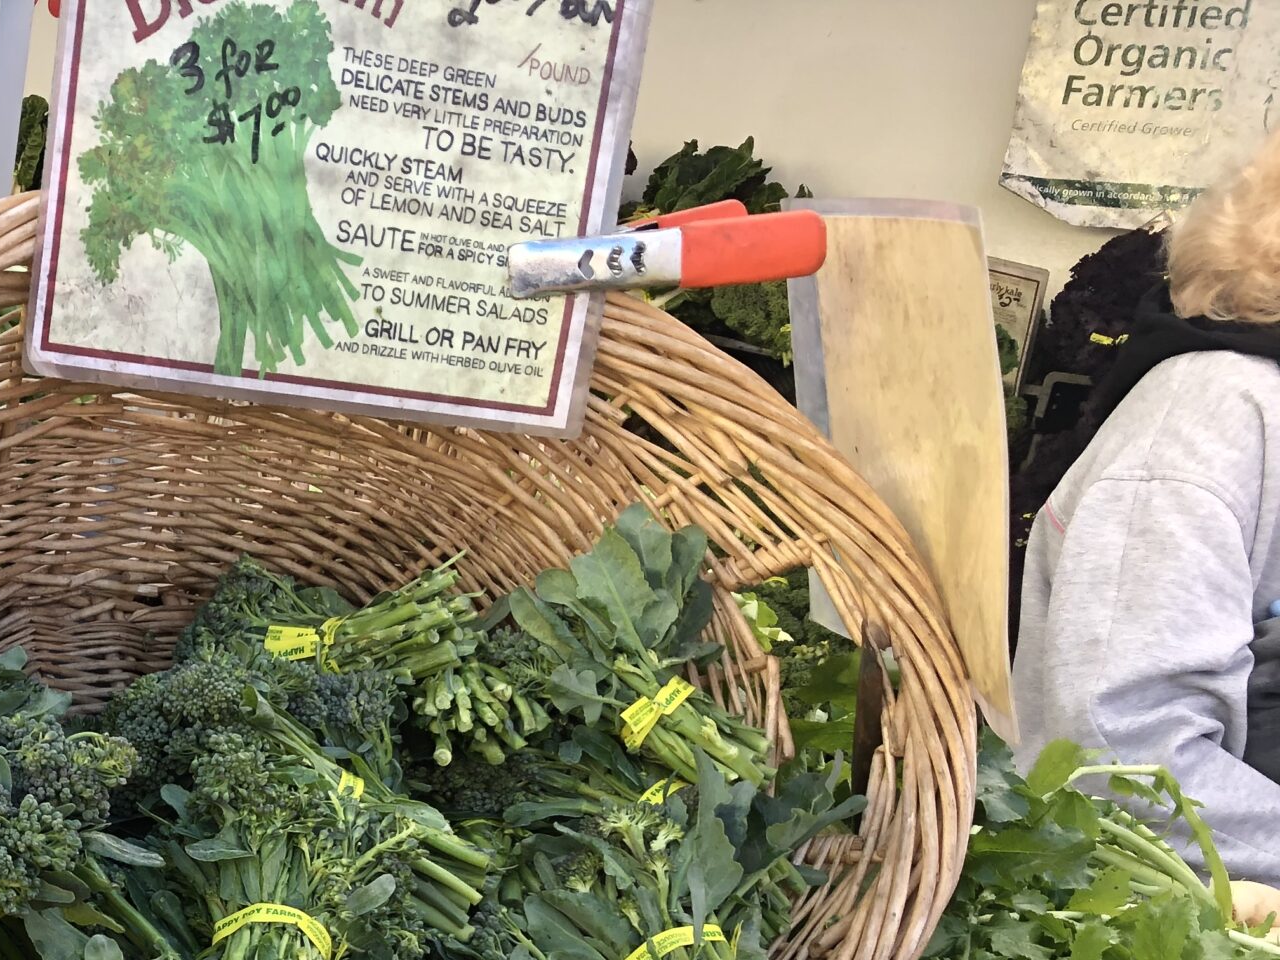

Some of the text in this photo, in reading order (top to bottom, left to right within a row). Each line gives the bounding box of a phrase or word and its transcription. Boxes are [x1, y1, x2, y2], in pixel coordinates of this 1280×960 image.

[1074, 0, 1252, 30] Certified
[170, 41, 205, 95] 3
[343, 47, 497, 89] THESE DEEP GREEN
[1073, 33, 1233, 77] Organic
[341, 69, 587, 128] DELICATE STEMS AND BUDS
[1061, 75, 1223, 111] Farmers
[349, 95, 583, 147] NEED VERY LITTLE PREPARATION
[1071, 119, 1138, 134] Certified
[315, 142, 463, 184] QUICKLY STEAM
[422, 126, 575, 174] TO BE TASTY.
[341, 187, 566, 238] OF LEMON AND SEA SALT
[345, 169, 568, 218] AND SERVE WITH A SQUEEZE
[1062, 188, 1093, 201] grown
[1095, 188, 1104, 198] in
[336, 219, 416, 252] SAUTE
[418, 242, 443, 257] FOR
[446, 247, 454, 260] A
[457, 248, 495, 265] SPICY
[431, 234, 447, 244] HOT
[448, 236, 472, 249] OLIVE
[473, 240, 486, 251] OIL
[487, 243, 505, 253] AND
[362, 267, 371, 278] A
[371, 268, 408, 283] SWEET
[411, 274, 434, 288] AND
[436, 276, 497, 296] FLAVORFUL
[361, 282, 548, 325] TO SUMMER SALADS
[335, 341, 359, 354] AND
[362, 343, 407, 360] DRIZZLE
[411, 351, 439, 364] WITH
[441, 354, 486, 370] HERBED
[489, 360, 522, 375] OLIVE
[364, 318, 547, 361] GRILL OR PAN FRY
[265, 907, 303, 921] FARMS
